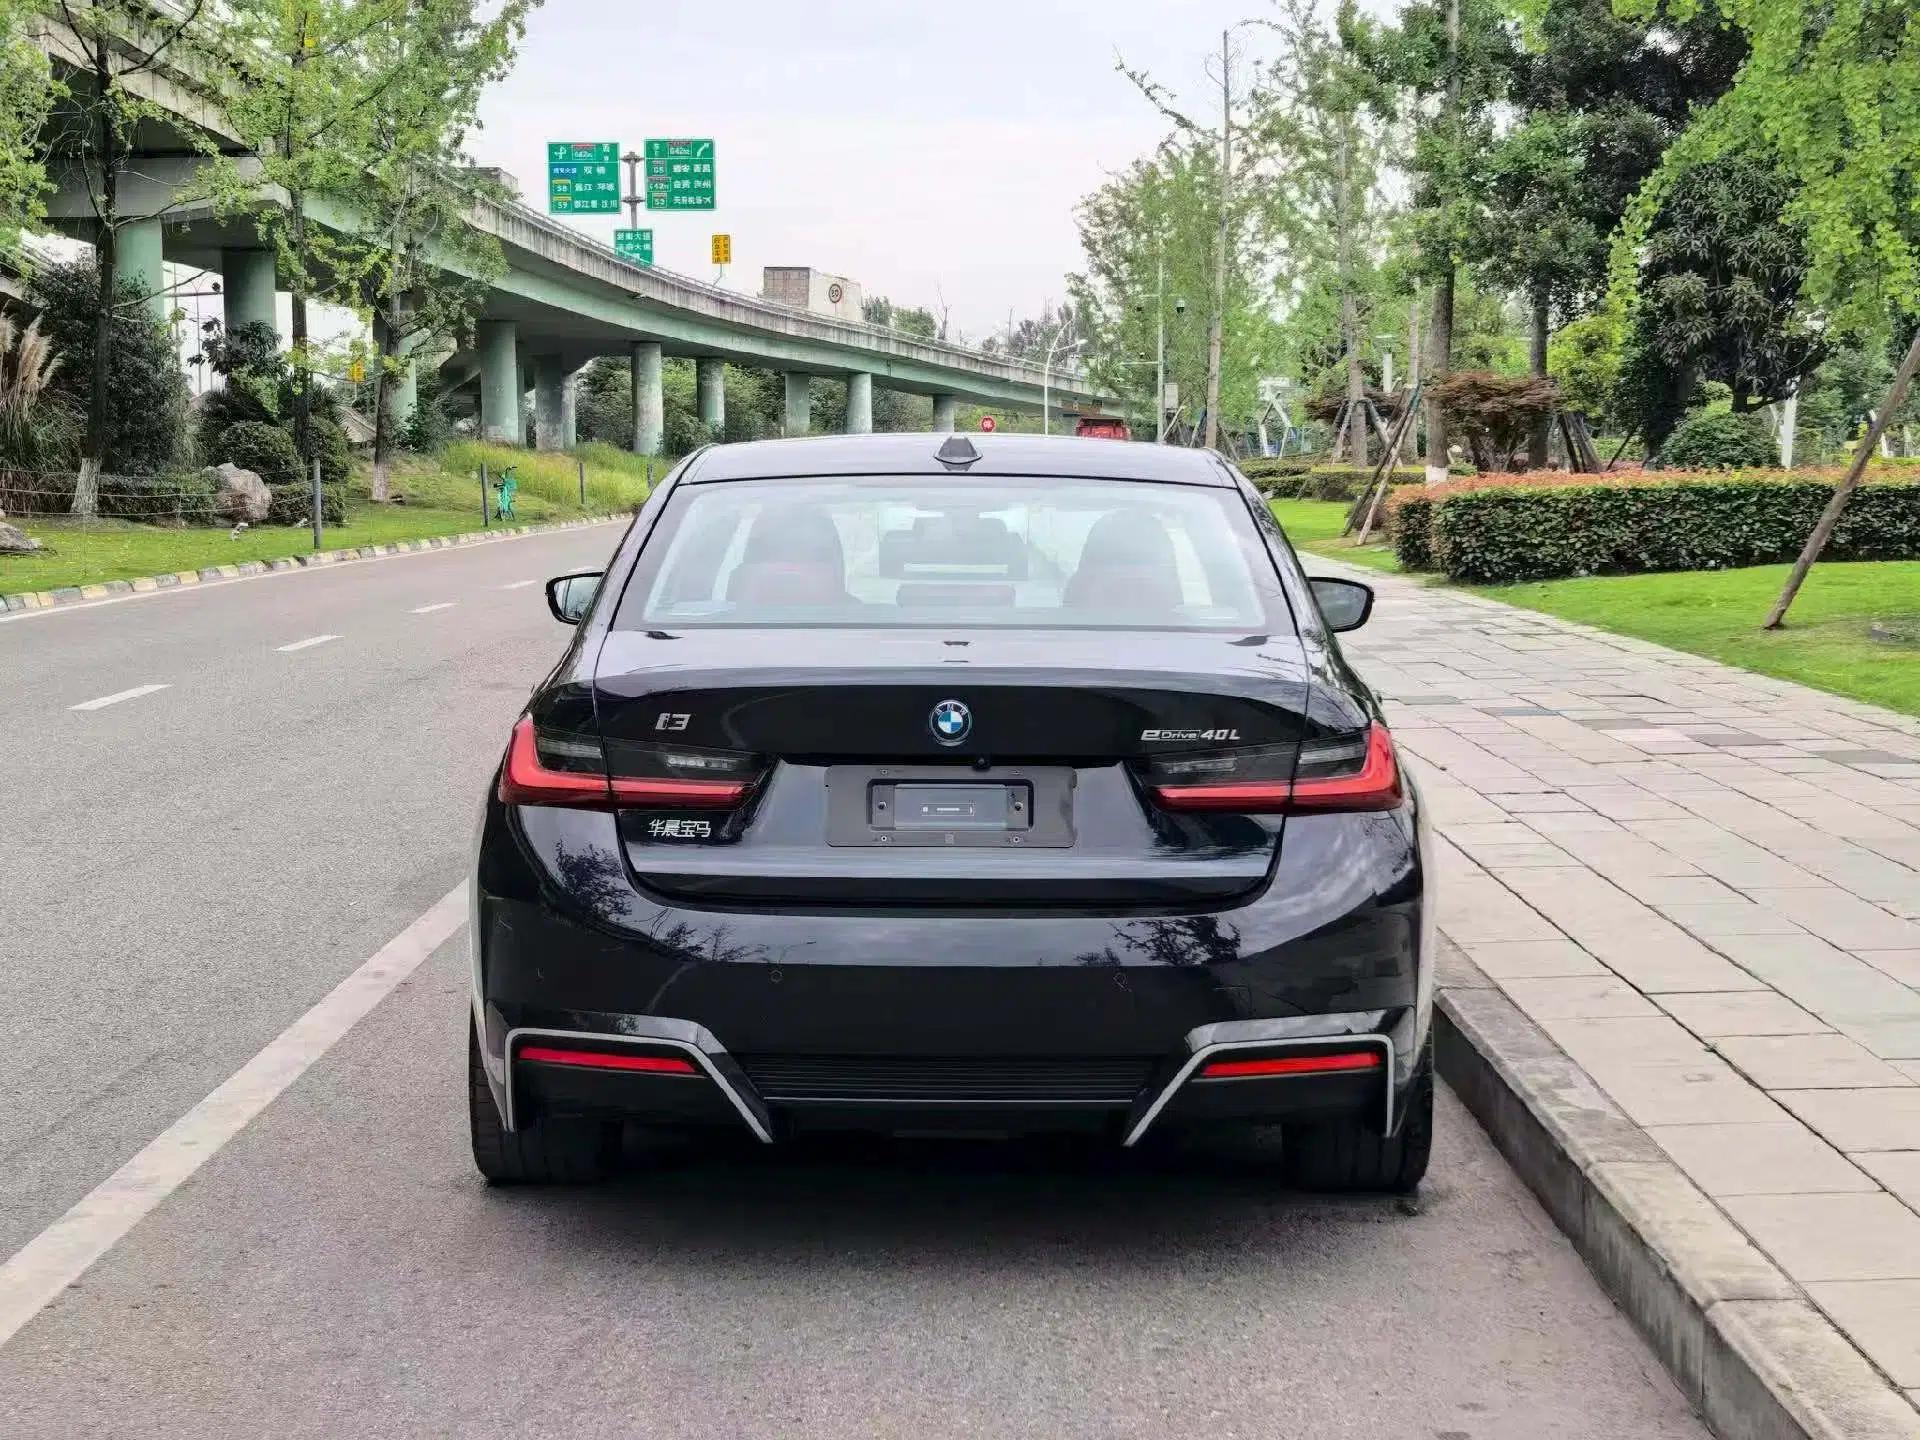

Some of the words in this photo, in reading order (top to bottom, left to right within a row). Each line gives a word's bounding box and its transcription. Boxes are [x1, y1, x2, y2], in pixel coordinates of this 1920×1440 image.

[655, 712, 691, 731] i3
[647, 818, 712, 838] 华晨宝马
